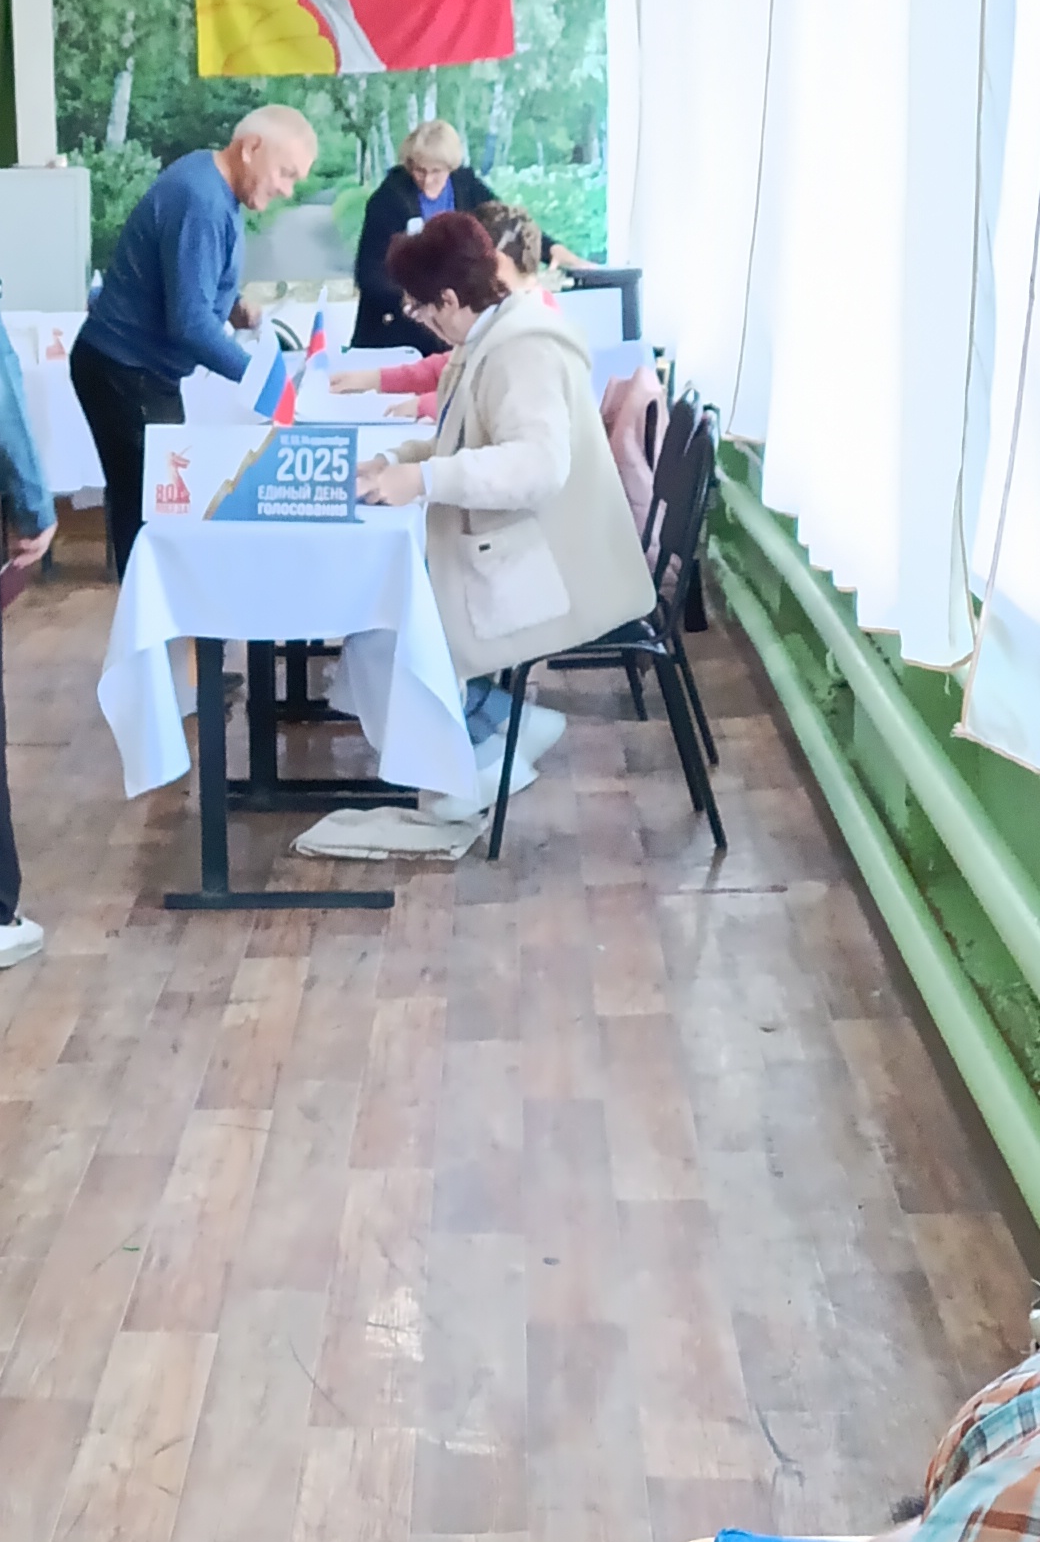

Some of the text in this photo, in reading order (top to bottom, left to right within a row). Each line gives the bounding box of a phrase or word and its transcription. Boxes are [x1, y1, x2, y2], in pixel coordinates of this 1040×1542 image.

[276, 447, 349, 482] 2025
[257, 483, 348, 501] ЕДИНЫЙ ДЕНЬ
